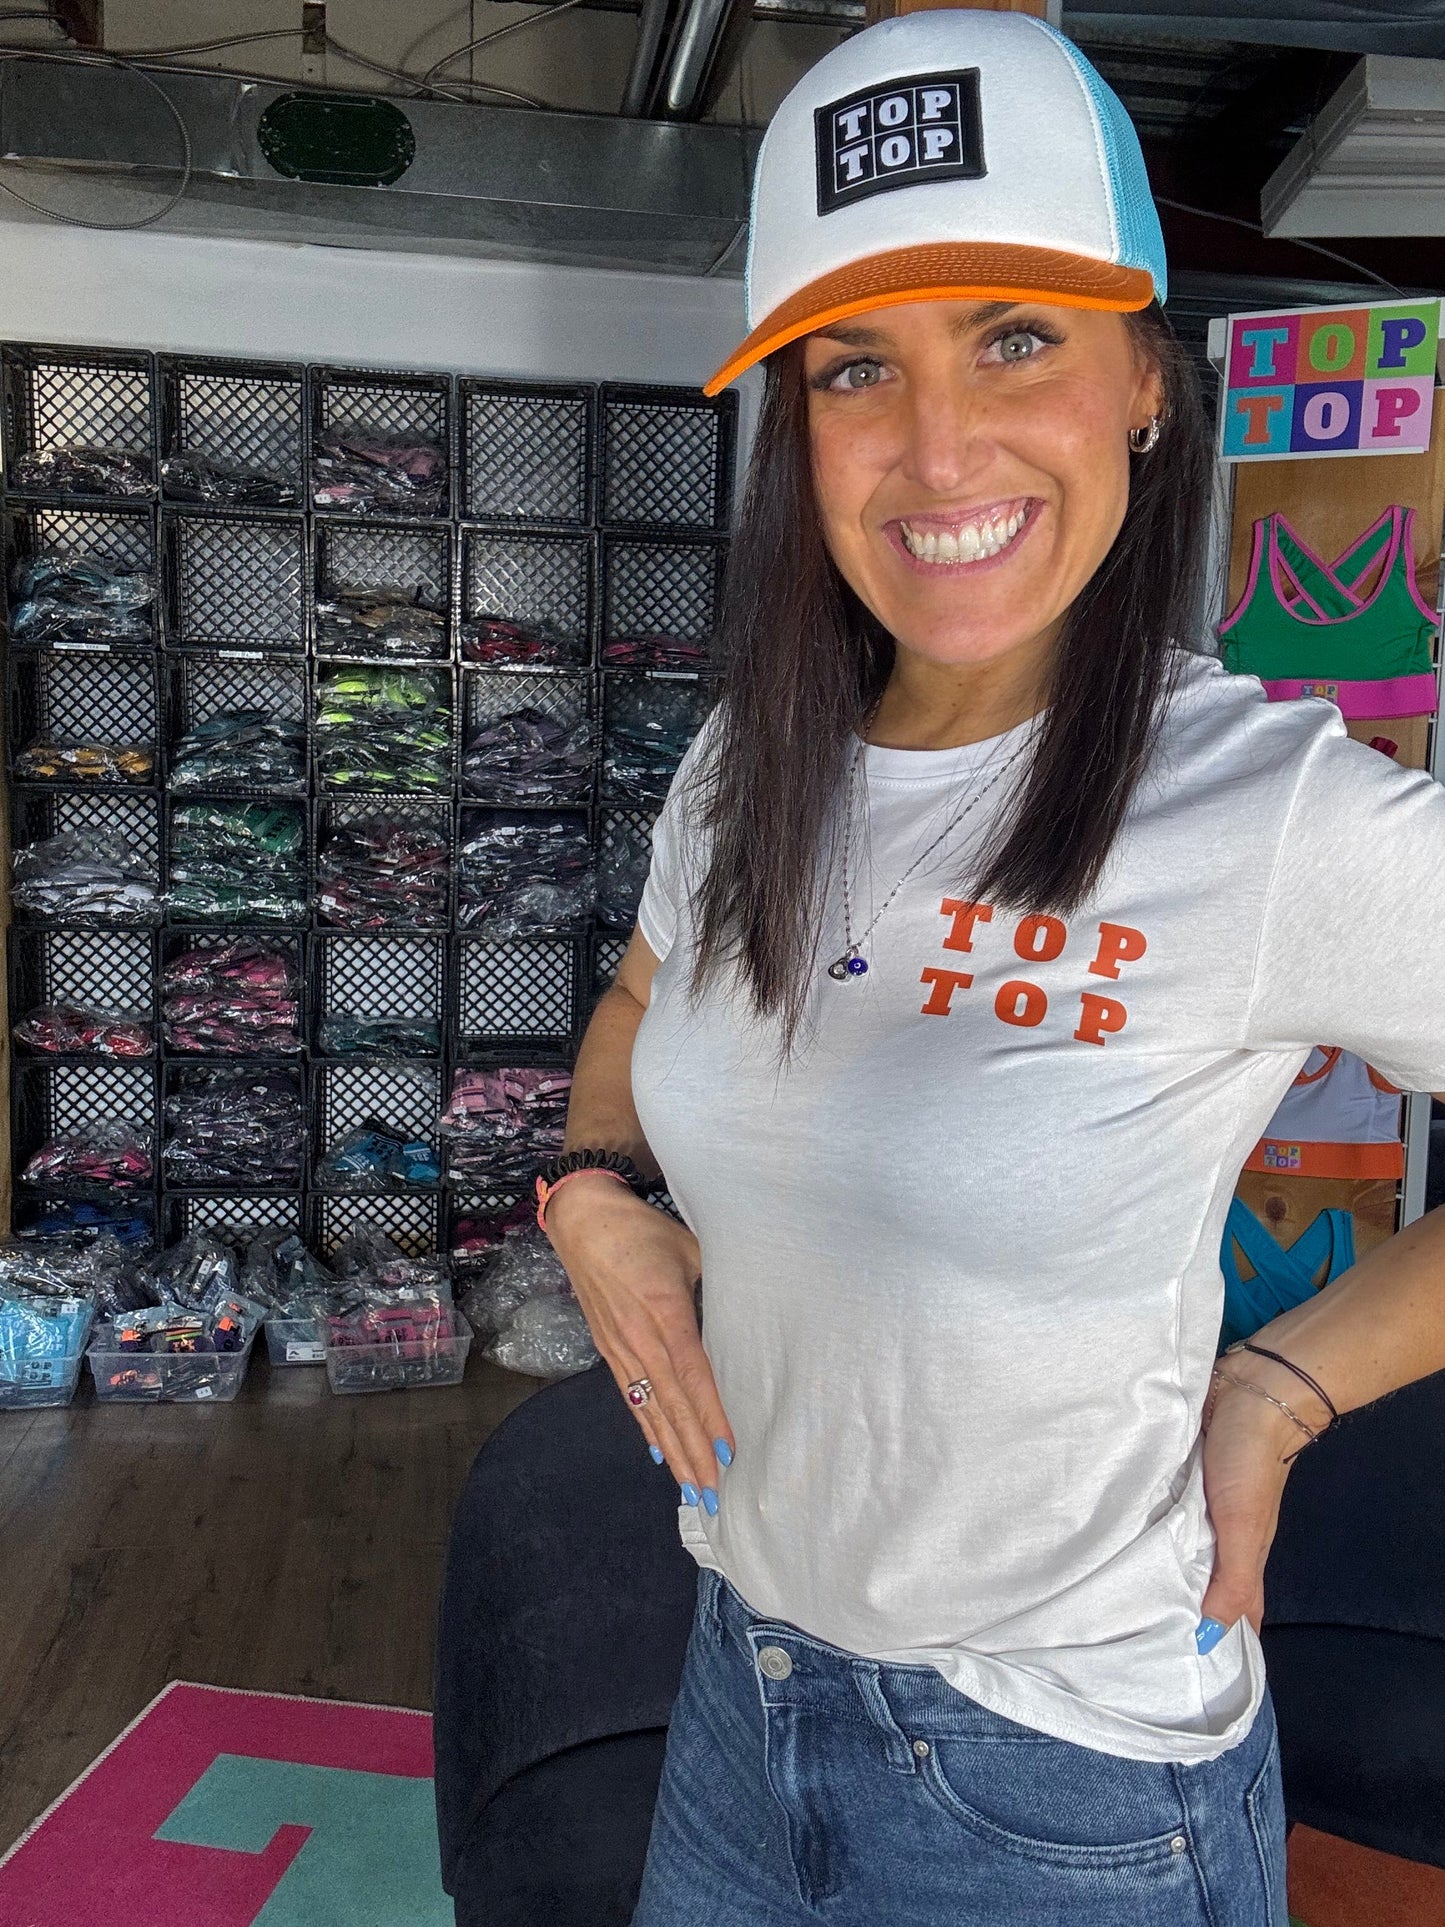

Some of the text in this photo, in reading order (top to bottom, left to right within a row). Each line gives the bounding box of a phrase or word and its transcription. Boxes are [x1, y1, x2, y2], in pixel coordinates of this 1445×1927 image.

[838, 89, 952, 141] TOP
[839, 127, 954, 181] TOP
[1241, 317, 1427, 378] TOP
[1236, 387, 1422, 445] TOP
[1303, 684, 1337, 695] TOP
[939, 897, 1148, 980] TOP
[919, 966, 1128, 1047] TOP
[1264, 1156, 1300, 1167] TOP
[1265, 1145, 1300, 1156] TOP
